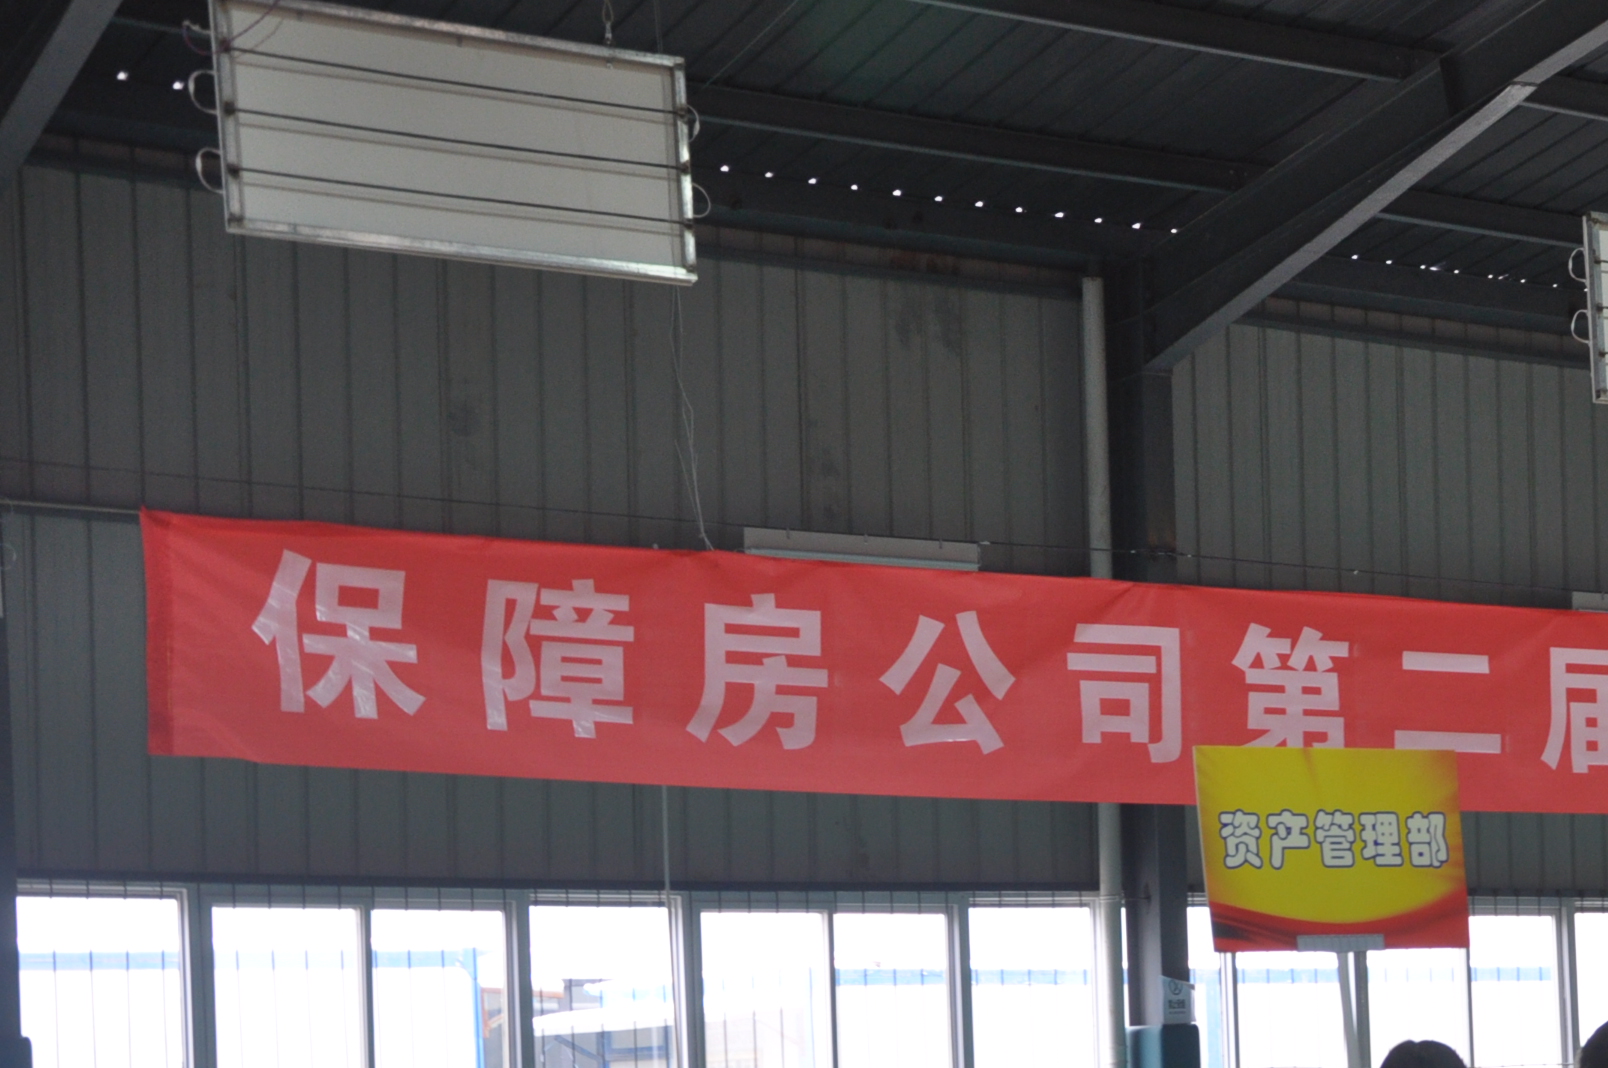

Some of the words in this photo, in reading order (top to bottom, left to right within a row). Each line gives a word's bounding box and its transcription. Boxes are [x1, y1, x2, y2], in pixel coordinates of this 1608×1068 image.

[1218, 809, 1449, 870] 资产管理部
